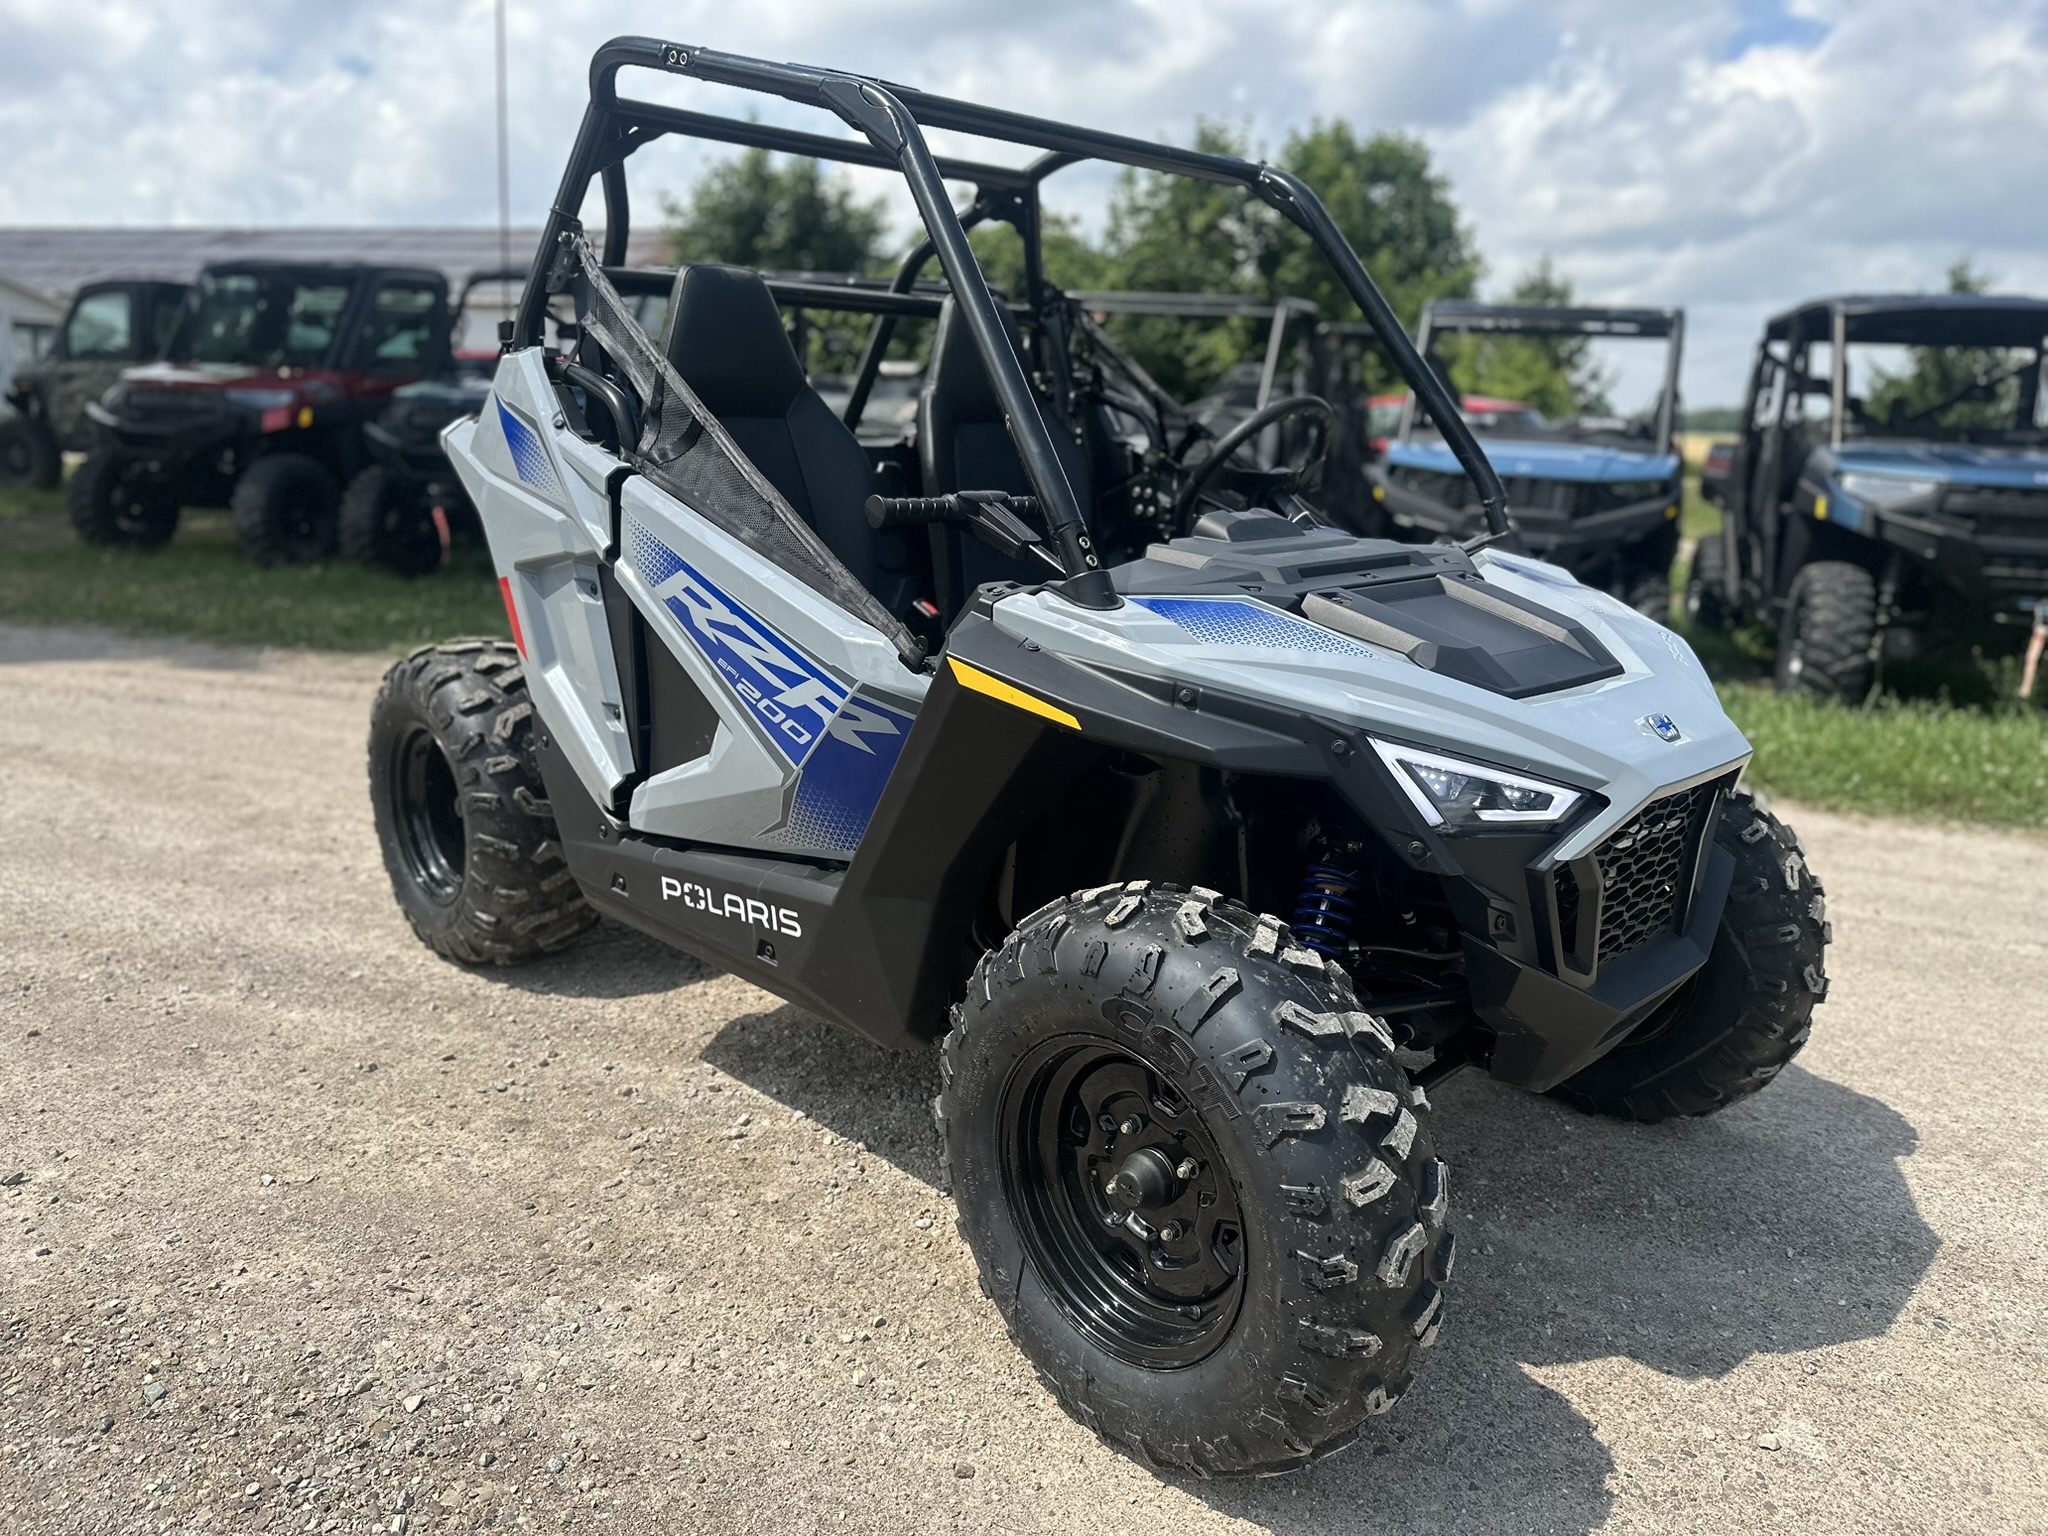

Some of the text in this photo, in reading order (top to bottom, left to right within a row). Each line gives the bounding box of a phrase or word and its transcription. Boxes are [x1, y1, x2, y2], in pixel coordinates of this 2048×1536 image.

[654, 569, 900, 755] RZR
[717, 658, 812, 744] EFI 200
[661, 876, 802, 938] POLARIS
[1101, 996, 1242, 1121] CST
